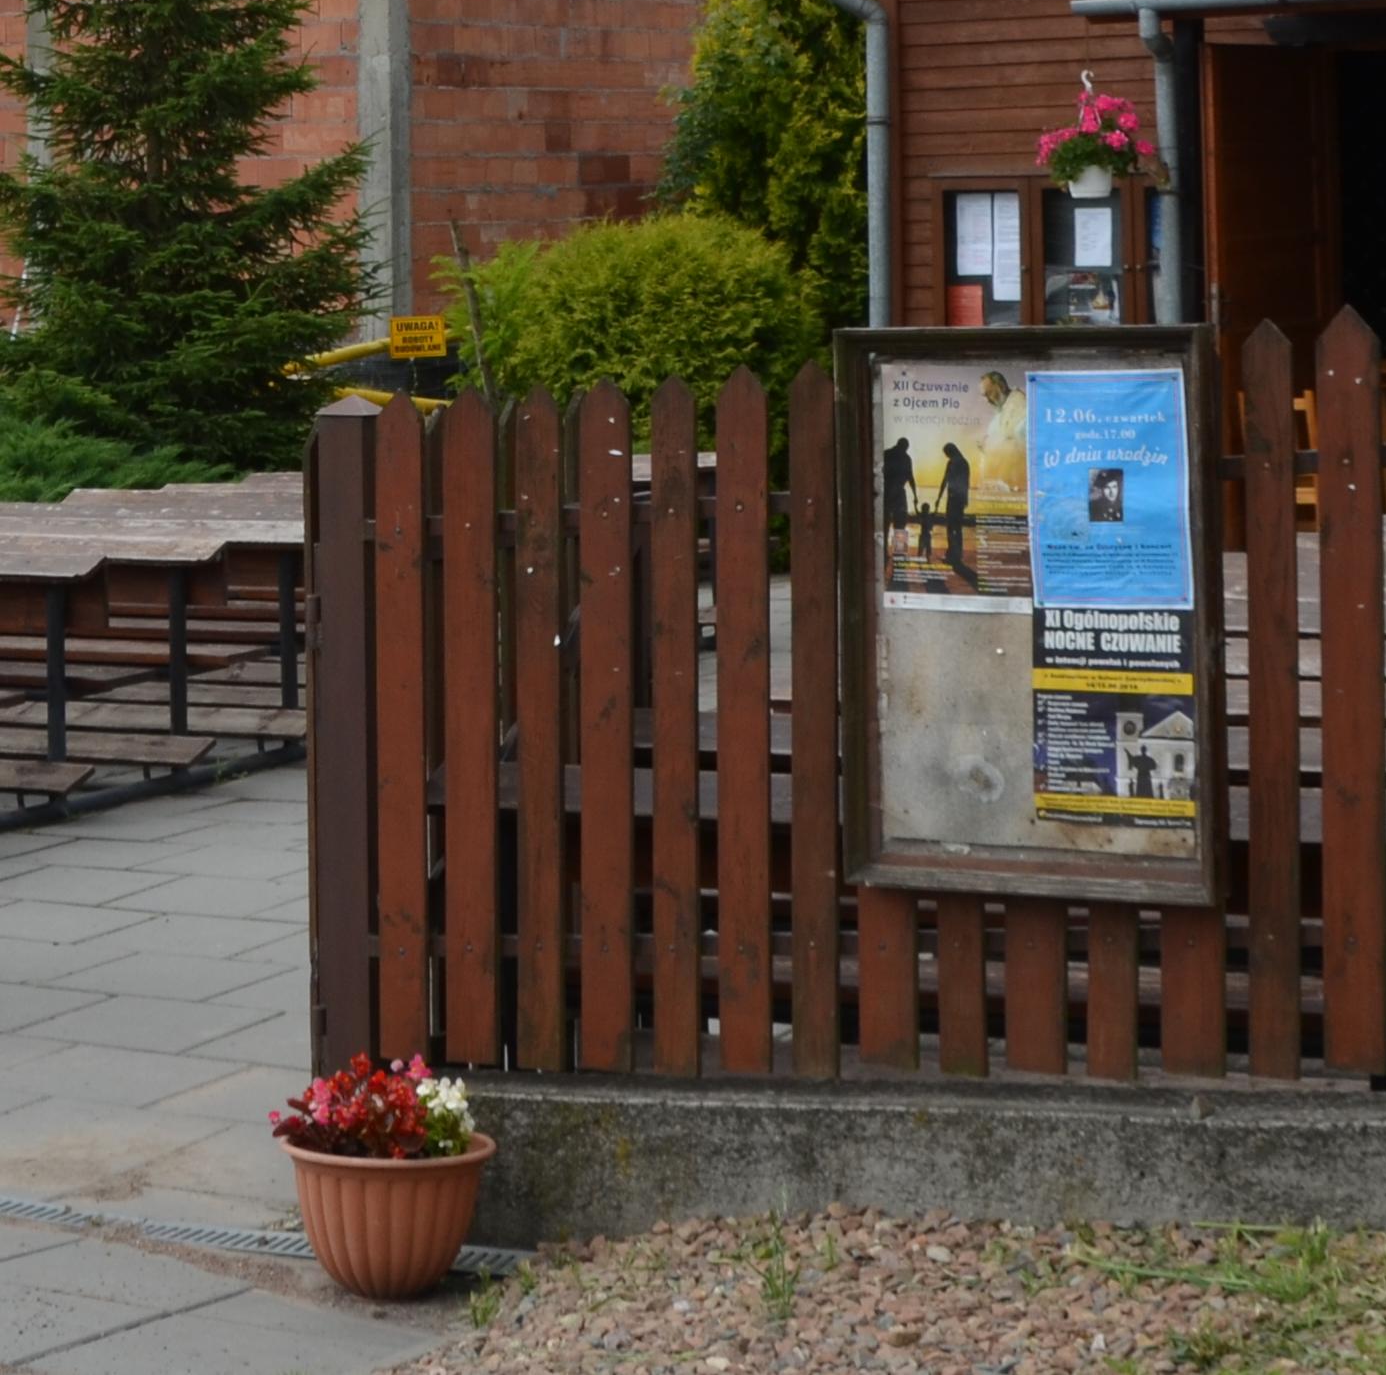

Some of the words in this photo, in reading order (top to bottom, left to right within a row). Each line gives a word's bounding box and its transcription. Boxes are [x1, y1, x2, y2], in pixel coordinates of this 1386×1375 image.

[396, 321, 438, 332] UWAGA!
[893, 380, 909, 391] XII
[912, 380, 969, 393] Czuwanie
[893, 398, 900, 407] z
[903, 396, 939, 410] Ojcem
[942, 397, 960, 409] Pio
[1044, 609, 1061, 628] XI
[1063, 610, 1181, 632] Ogólnopolskie
[1044, 630, 1096, 651] NOCNE
[1100, 631, 1182, 653] CZUWANIE
